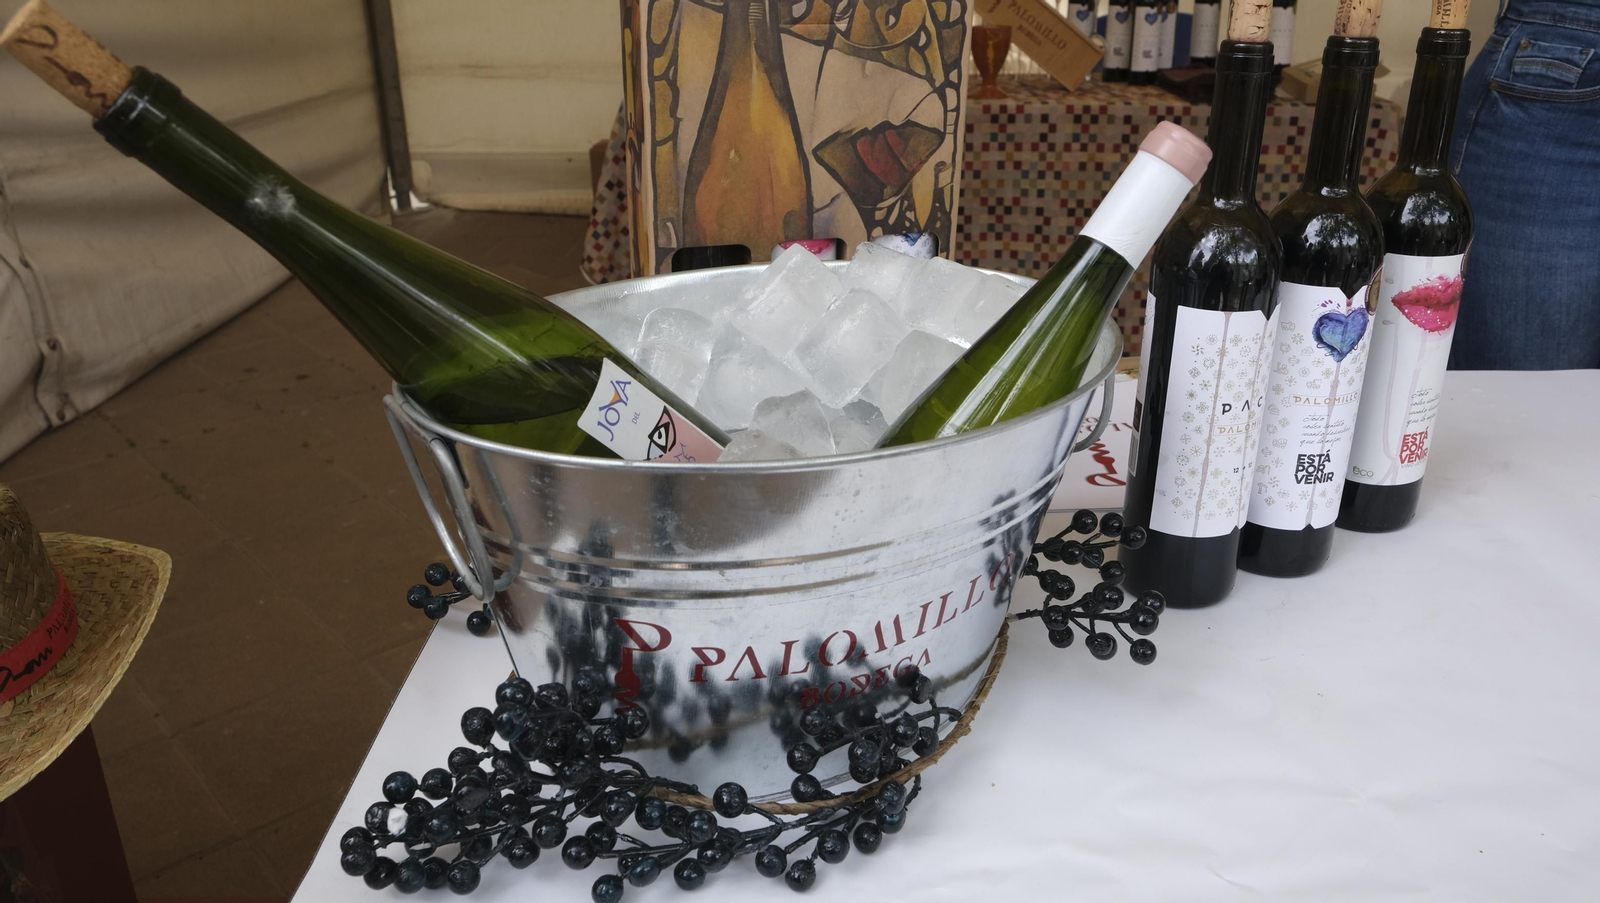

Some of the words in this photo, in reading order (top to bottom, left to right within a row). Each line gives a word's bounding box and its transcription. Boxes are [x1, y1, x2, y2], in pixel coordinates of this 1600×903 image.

[1293, 391, 1359, 405] PALOMILLO
[597, 380, 632, 442] JOYA
[631, 412, 640, 425] DEL
[1402, 426, 1429, 444] ESTÁ
[1399, 447, 1429, 464] VENIR
[1400, 441, 1424, 455] POR
[1297, 449, 1331, 465] ESTÁ
[1295, 464, 1326, 475] POR
[1353, 465, 1374, 477] eco
[1294, 472, 1334, 485] VENIR
[689, 553, 1015, 683] PALOMILLO
[800, 648, 932, 710] BODEGA
